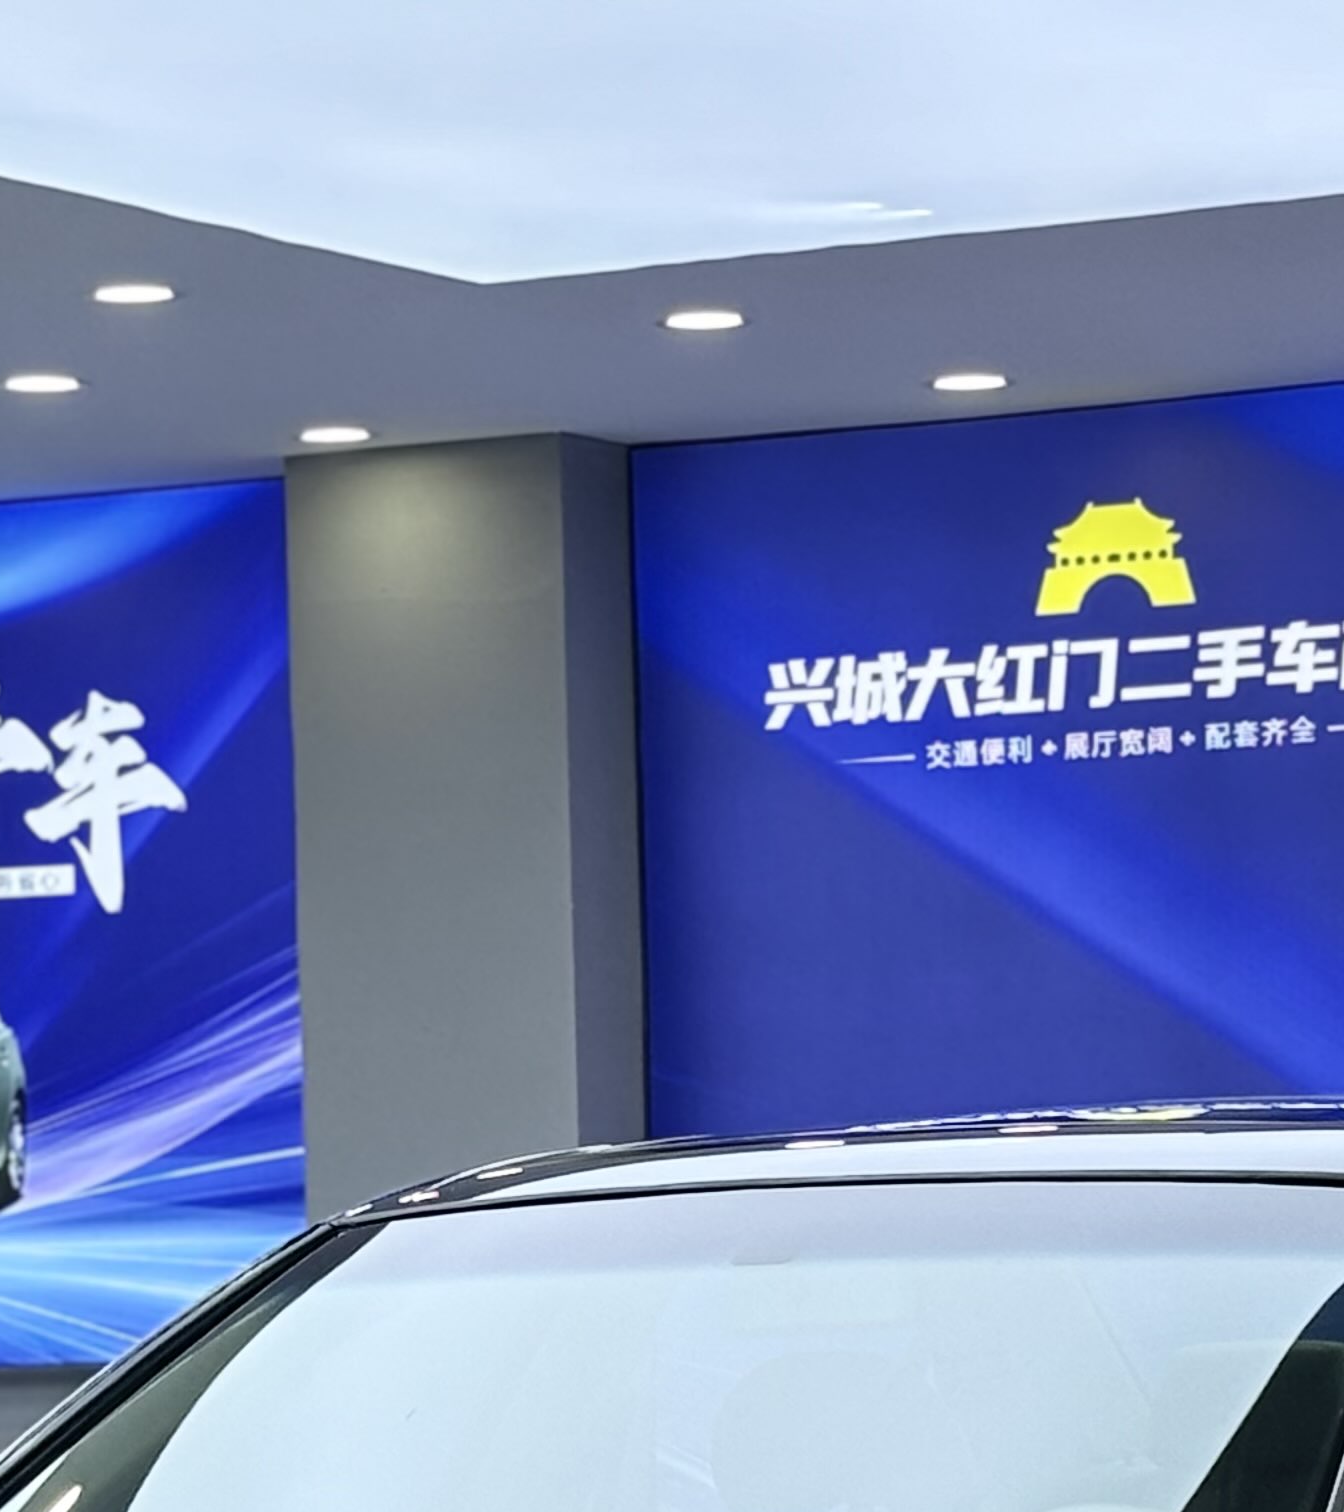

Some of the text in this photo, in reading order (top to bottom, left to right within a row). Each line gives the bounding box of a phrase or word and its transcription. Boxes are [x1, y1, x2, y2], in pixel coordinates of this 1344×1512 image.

[925, 715, 1317, 770] 交通便利 展厅宽阔 配套齐全
